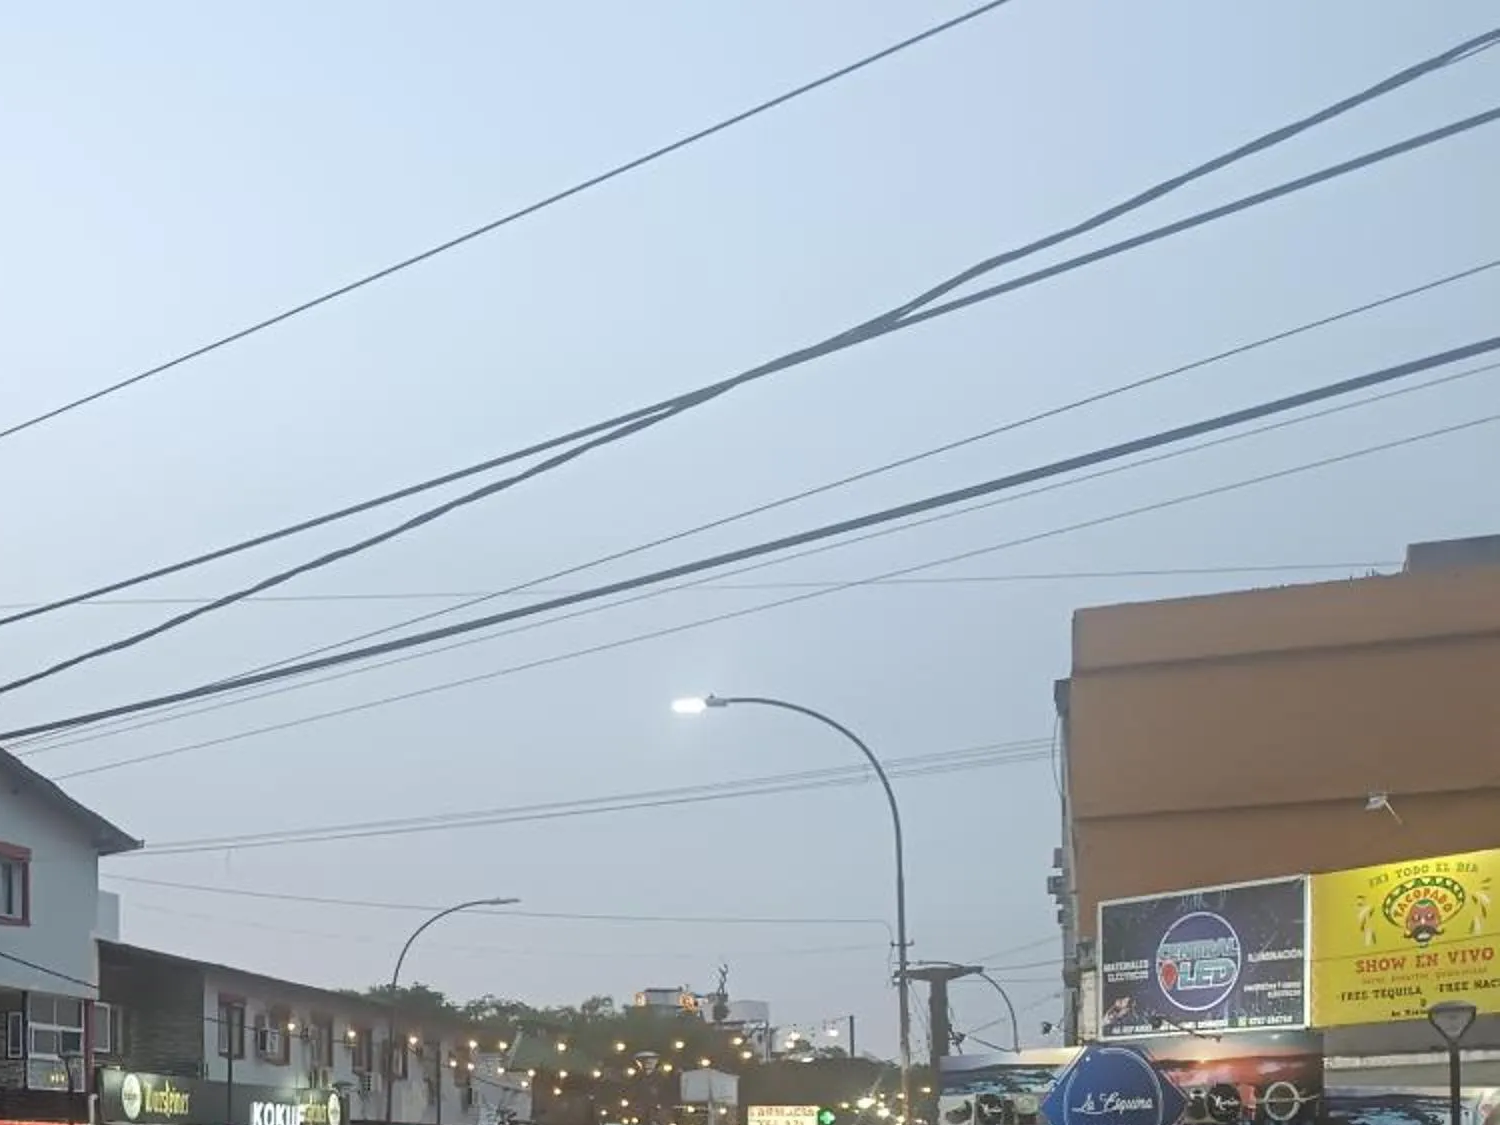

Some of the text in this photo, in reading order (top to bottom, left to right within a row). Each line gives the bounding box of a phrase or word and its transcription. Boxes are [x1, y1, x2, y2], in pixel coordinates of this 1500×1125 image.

[1356, 947, 1495, 974] SHOW EN VIVO
[1372, 986, 1422, 1000] TEQUILA
[1438, 980, 1469, 993] FREE
